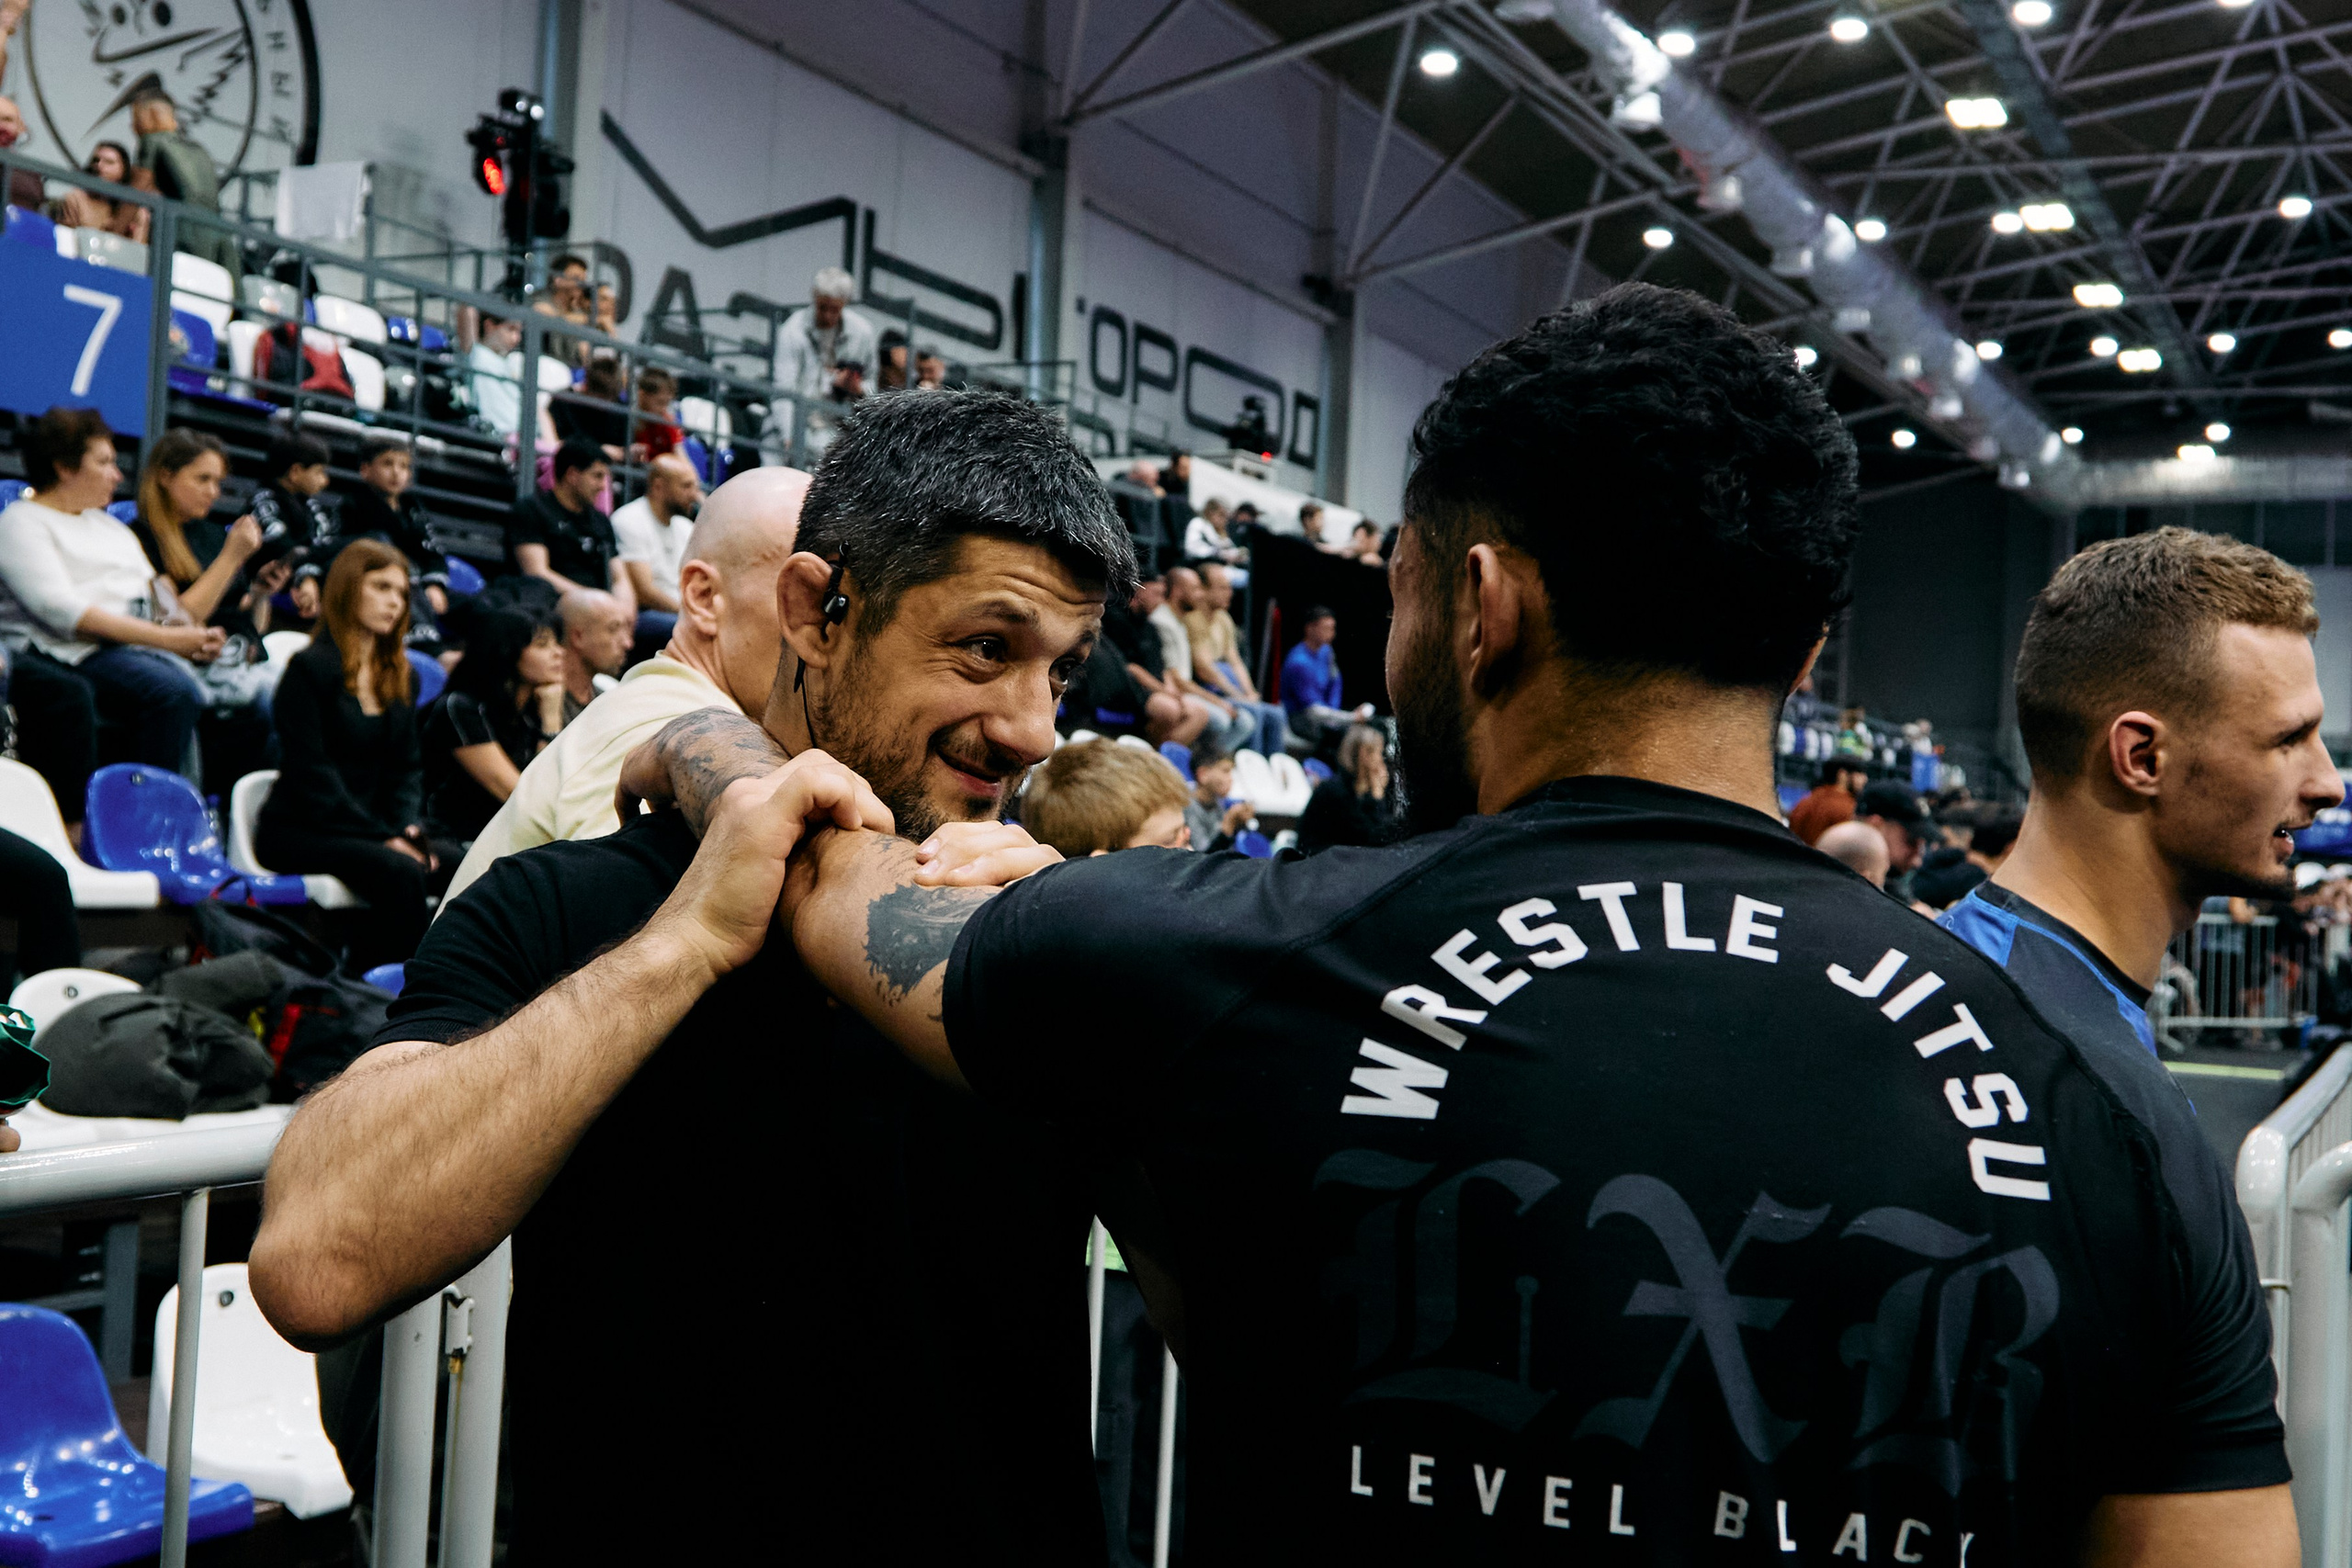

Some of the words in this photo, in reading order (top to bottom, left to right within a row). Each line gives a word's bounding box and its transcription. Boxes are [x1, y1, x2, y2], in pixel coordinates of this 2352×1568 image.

[62, 284, 123, 397] 7
[1340, 881, 1784, 1120] WRESTLE
[1826, 948, 2051, 1201] JITSU
[1350, 1445, 1635, 1535] LEVEL
